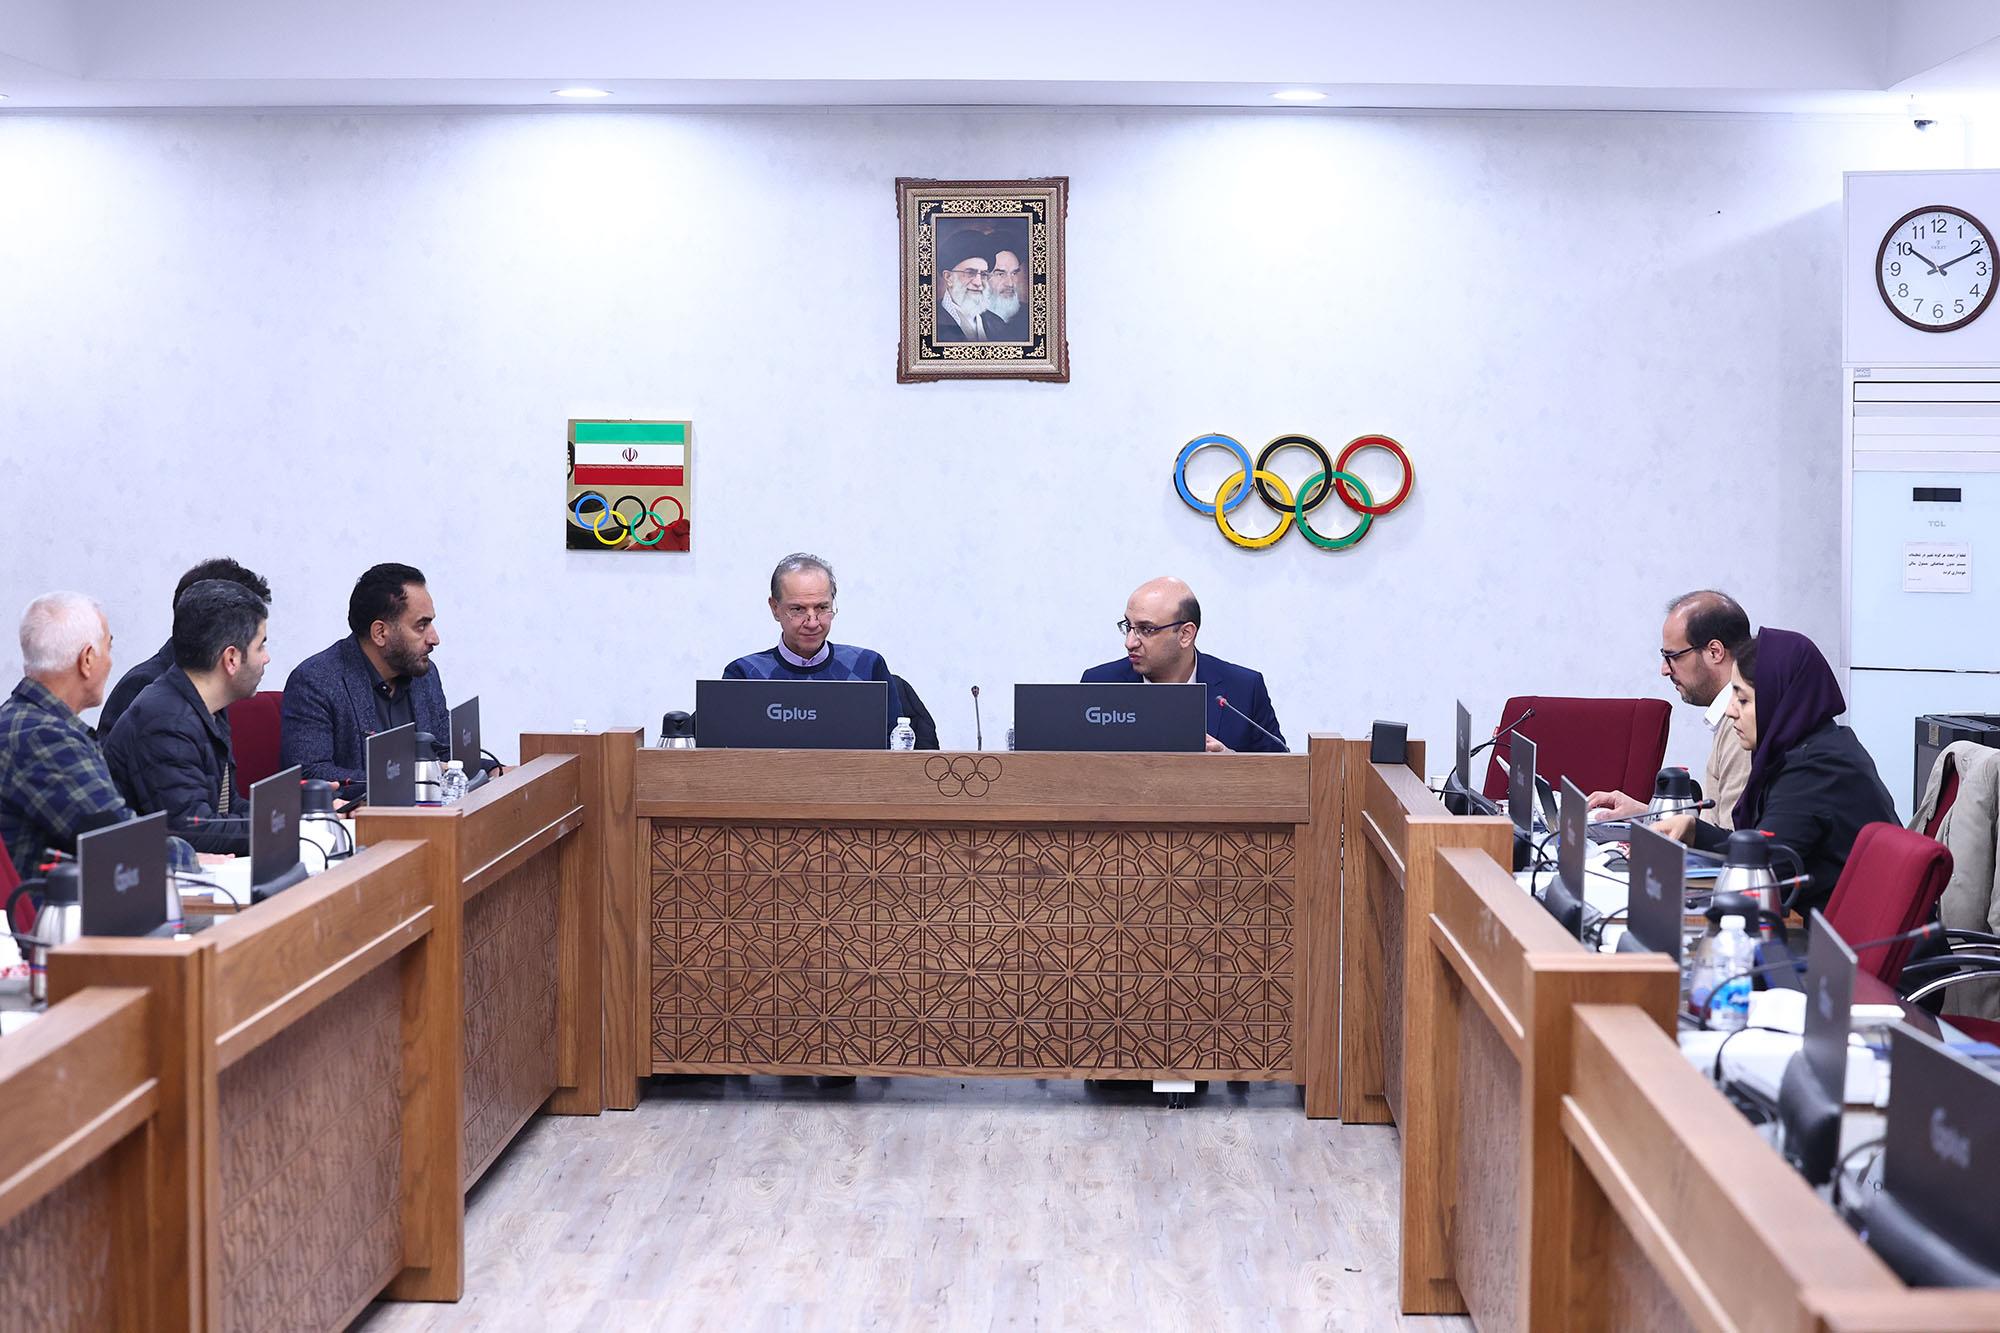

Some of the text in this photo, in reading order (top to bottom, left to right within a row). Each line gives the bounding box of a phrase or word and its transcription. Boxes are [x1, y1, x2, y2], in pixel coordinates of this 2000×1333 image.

[1912, 225, 1925, 239] 11
[1930, 218, 1948, 234] 12
[1957, 225, 1963, 239] 1
[1896, 241, 1913, 256] 10
[1970, 239, 1981, 254] 2
[1890, 261, 1901, 277] 9
[1976, 261, 1987, 276] 3
[1898, 282, 1909, 298] 8
[1969, 283, 1981, 298] 4
[1913, 298, 1924, 313] 7
[1932, 303, 1944, 319] 6
[1953, 299, 1965, 314] 5
[766, 703, 817, 722] Gplus
[1085, 706, 1136, 725] Gplus
